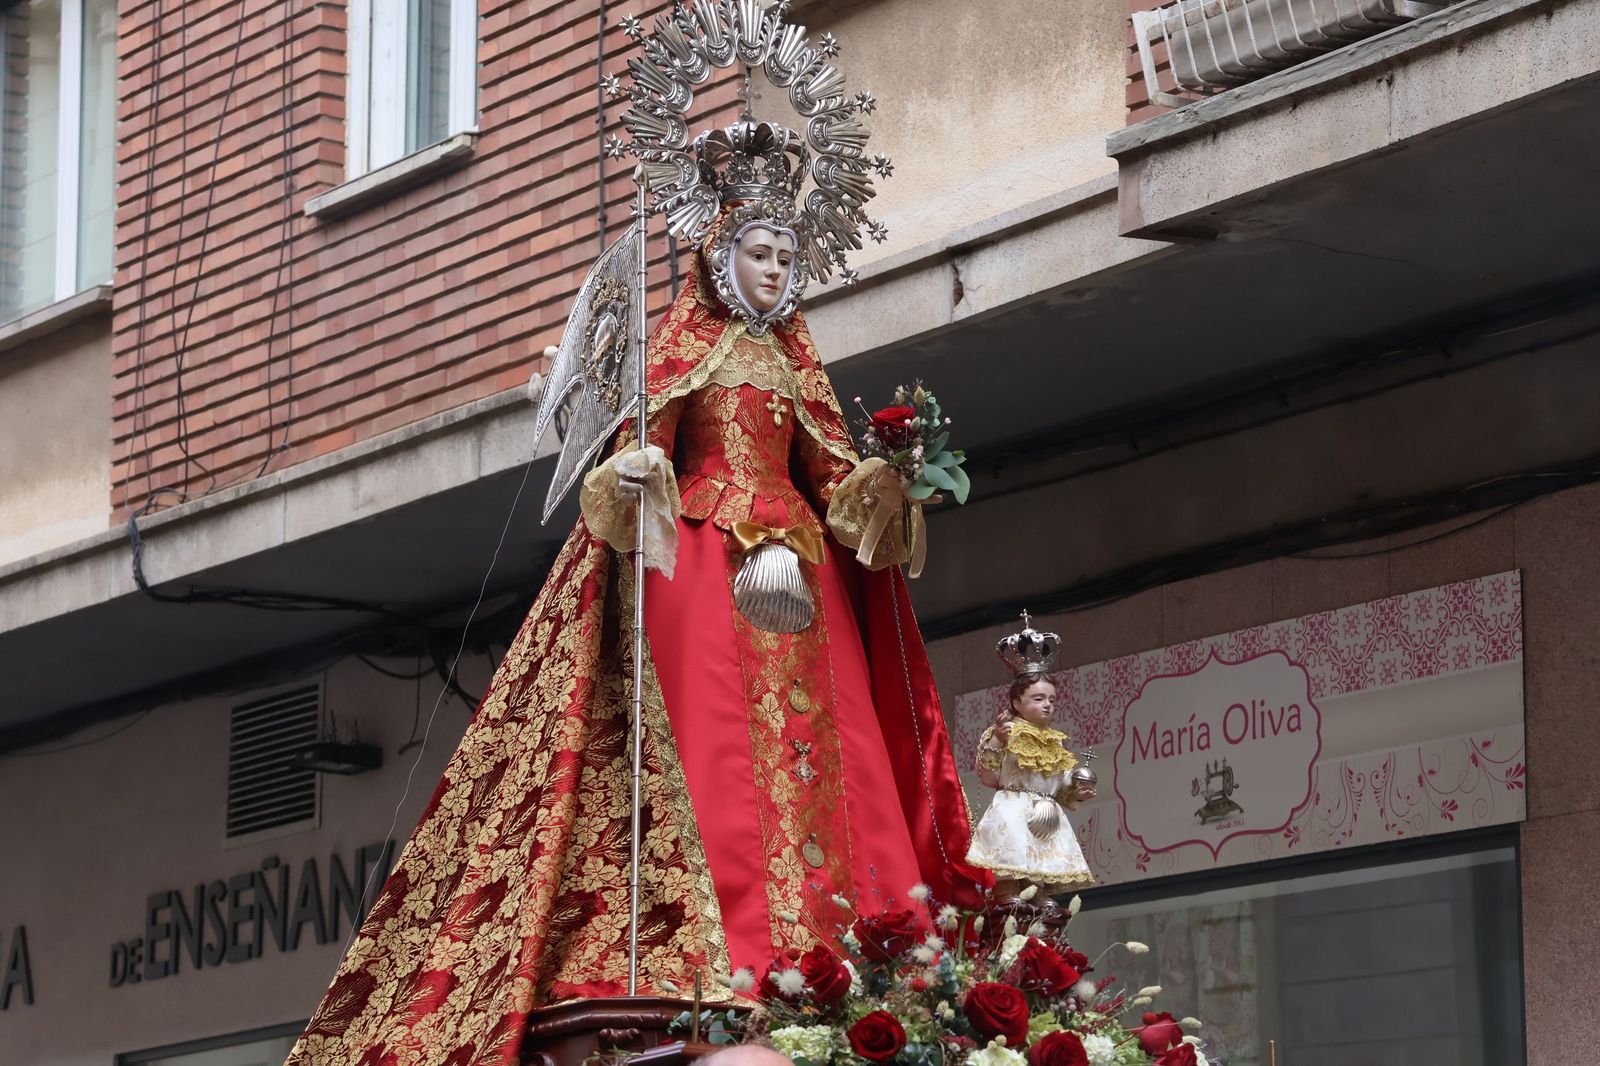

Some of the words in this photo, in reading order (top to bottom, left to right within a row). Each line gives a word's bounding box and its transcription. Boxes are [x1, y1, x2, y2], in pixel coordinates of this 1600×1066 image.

[1131, 713, 1211, 764] María
[1222, 699, 1302, 745] Oliva
[110, 938, 144, 987] DE
